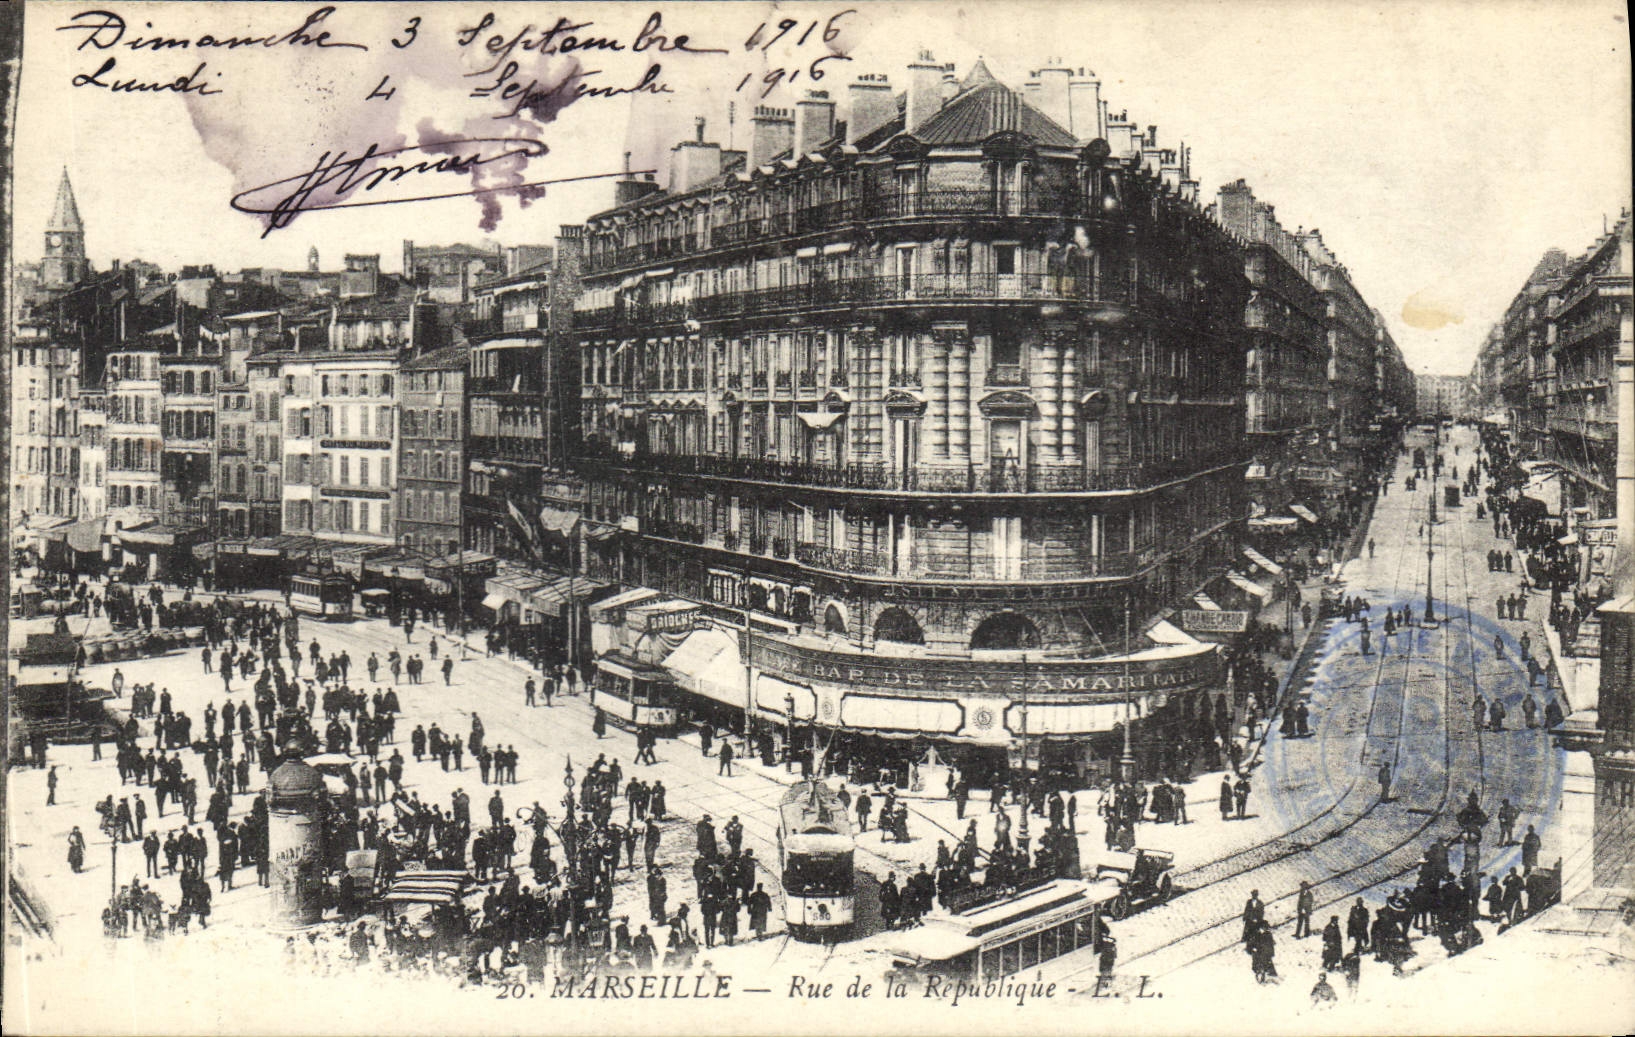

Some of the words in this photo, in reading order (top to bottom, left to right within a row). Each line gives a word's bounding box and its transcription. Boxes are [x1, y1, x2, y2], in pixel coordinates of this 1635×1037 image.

[56, 5, 368, 51] Dimanche
[391, 17, 421, 49] 3
[745, 9, 857, 52] 1916
[72, 57, 223, 95] Lundi
[366, 74, 397, 99] 4
[736, 55, 853, 98] 1916
[884, 671, 925, 686] DE
[943, 676, 990, 689] LA
